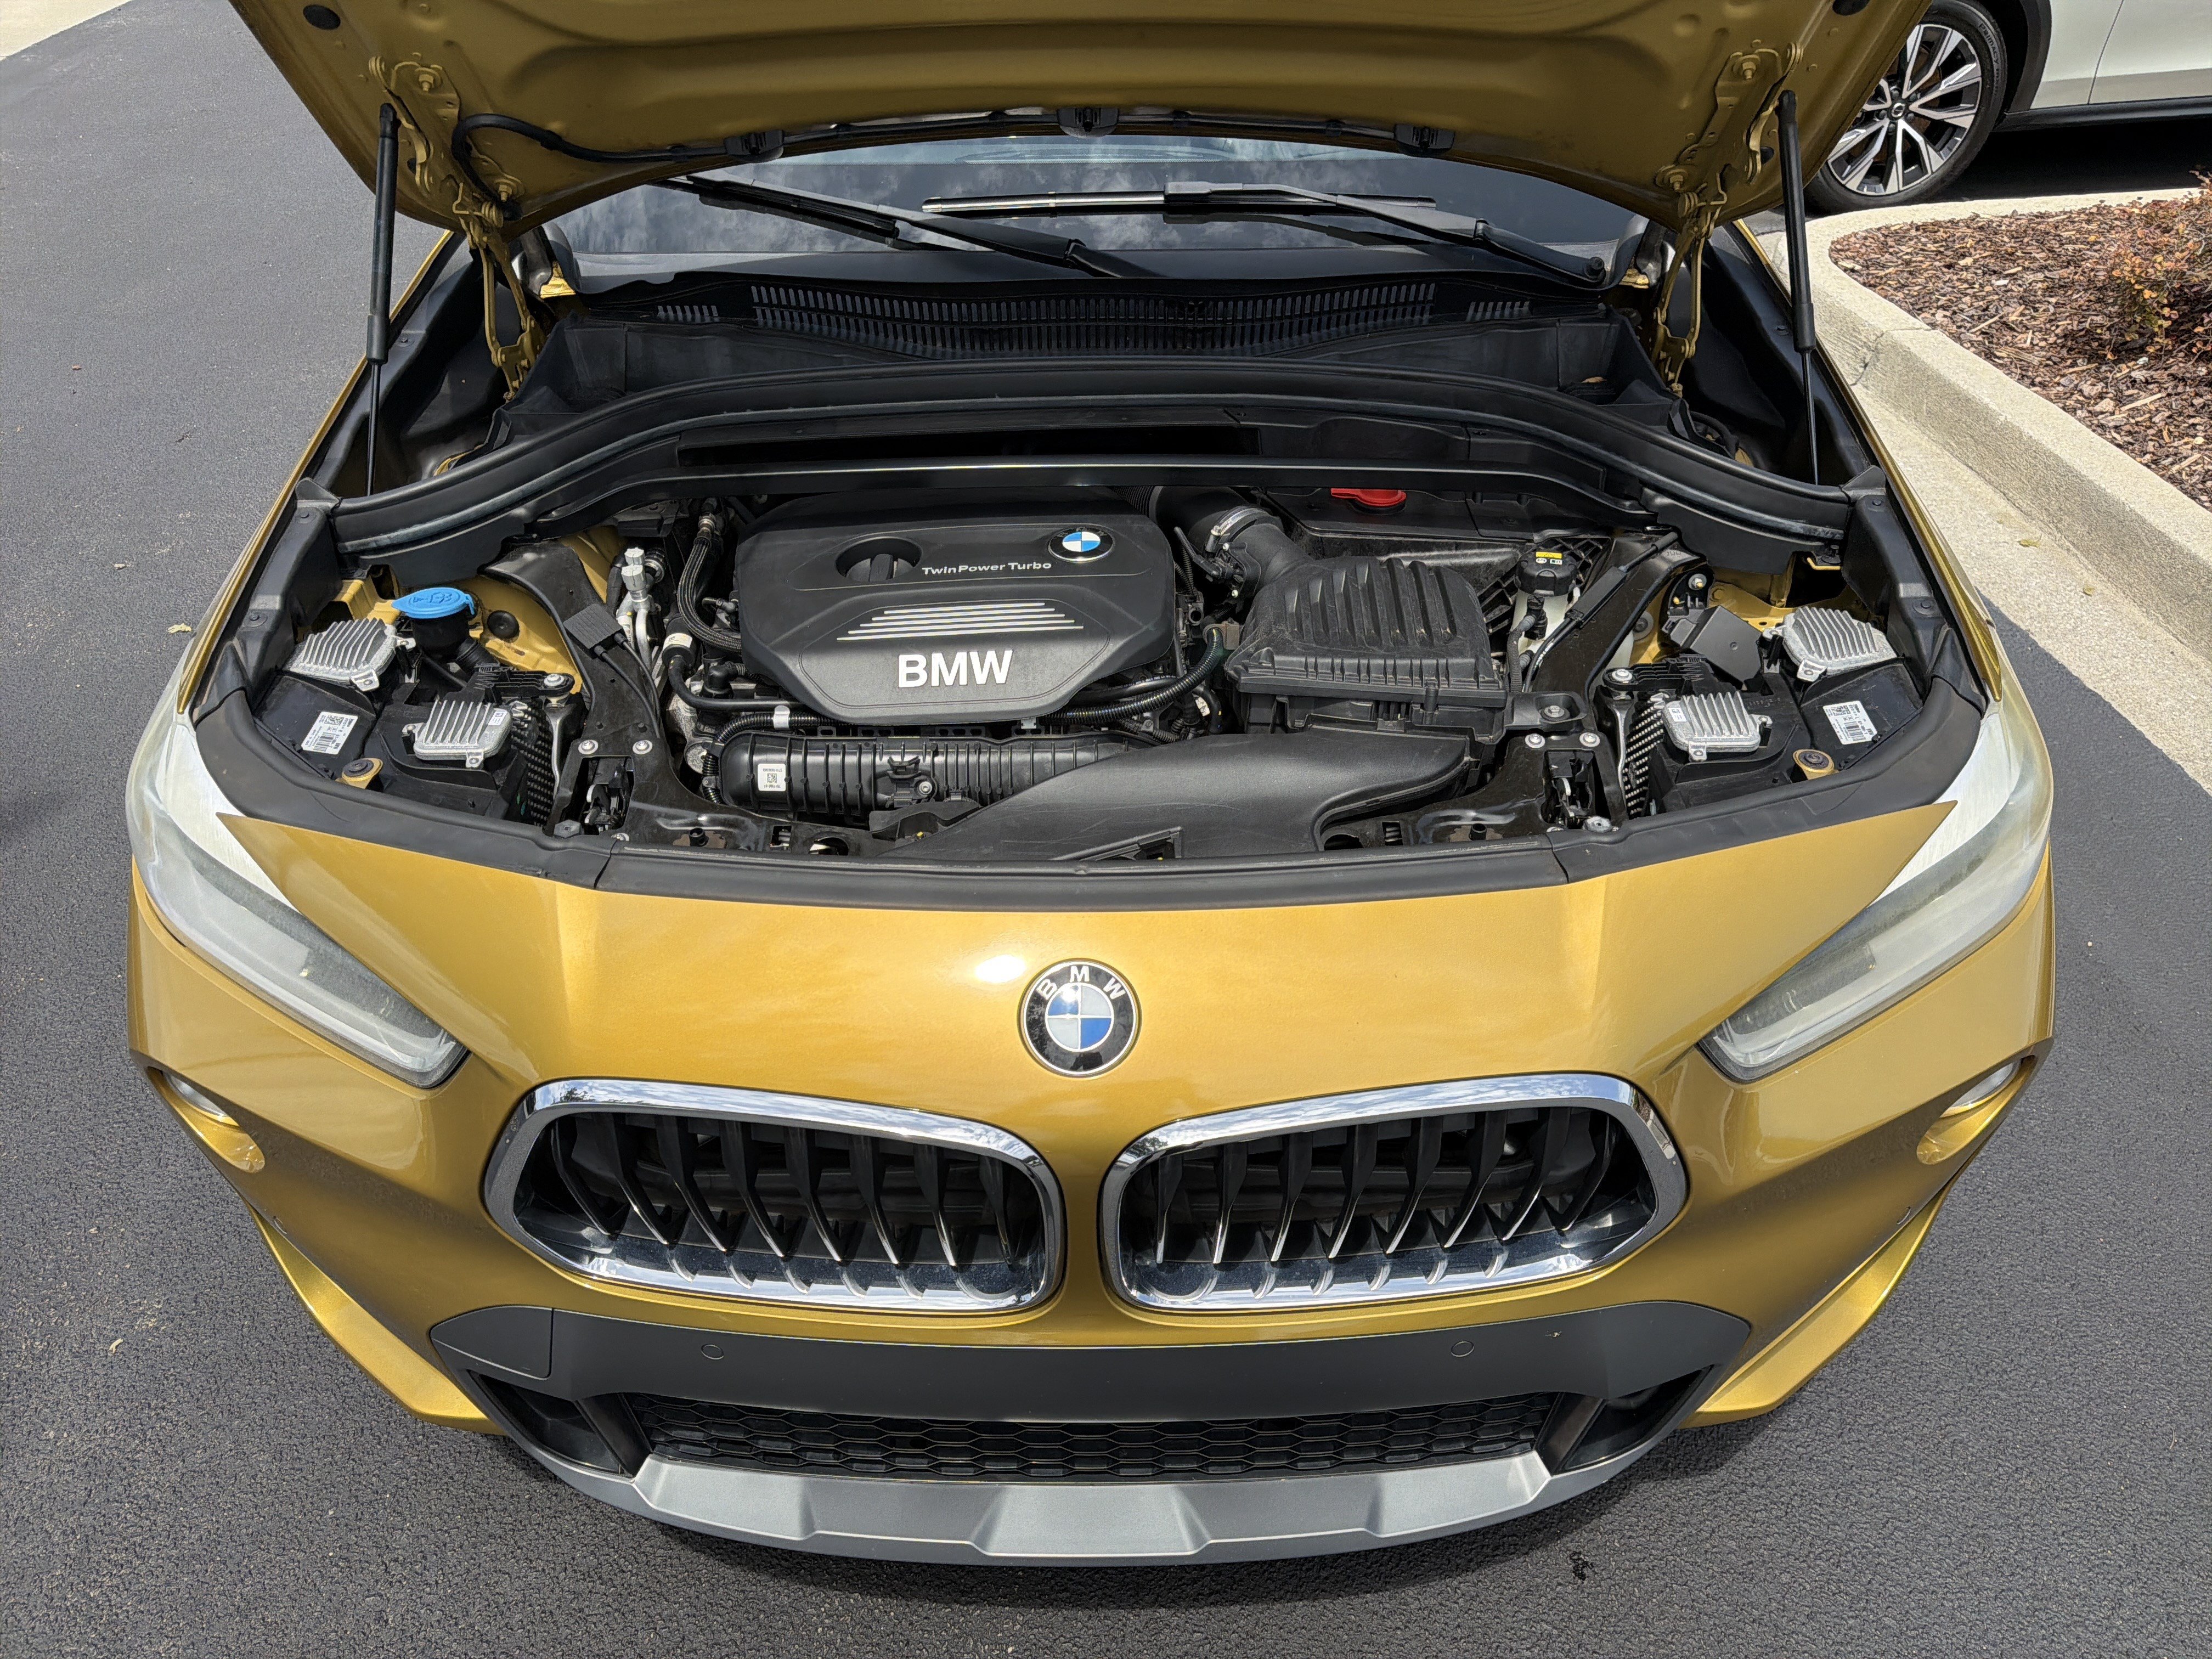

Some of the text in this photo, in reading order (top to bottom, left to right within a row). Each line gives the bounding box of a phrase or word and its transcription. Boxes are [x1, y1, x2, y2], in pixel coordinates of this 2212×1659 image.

[1056, 526, 1108, 538] BMW
[1008, 562, 1052, 570] Turbo
[899, 650, 1013, 687] BMW
[1035, 965, 1126, 1000] BMW
